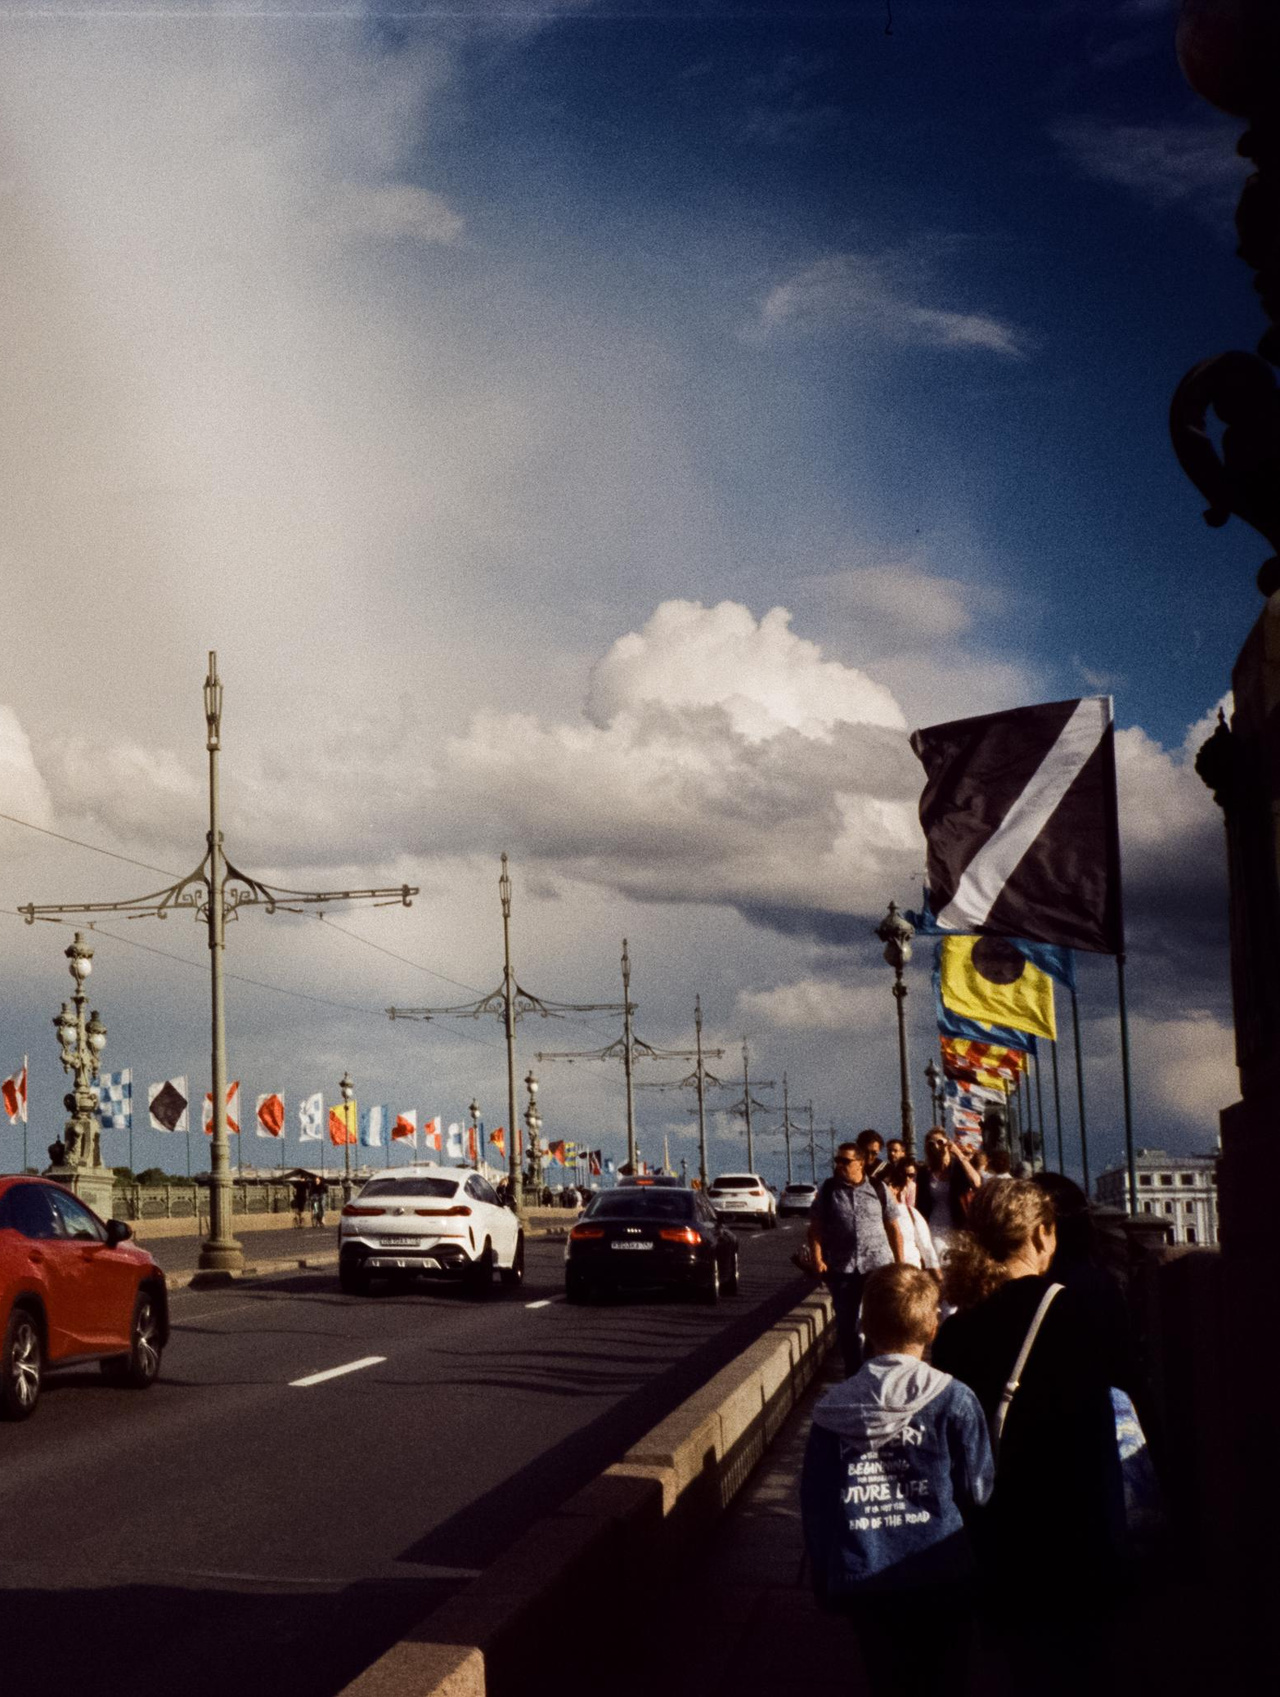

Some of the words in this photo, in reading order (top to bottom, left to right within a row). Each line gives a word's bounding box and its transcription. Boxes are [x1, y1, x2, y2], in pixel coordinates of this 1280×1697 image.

[896, 1480, 929, 1499] LIFE
[849, 1517, 869, 1530] END
[871, 1517, 882, 1529] OF
[884, 1514, 902, 1527] THE
[905, 1510, 930, 1524] ROAD
